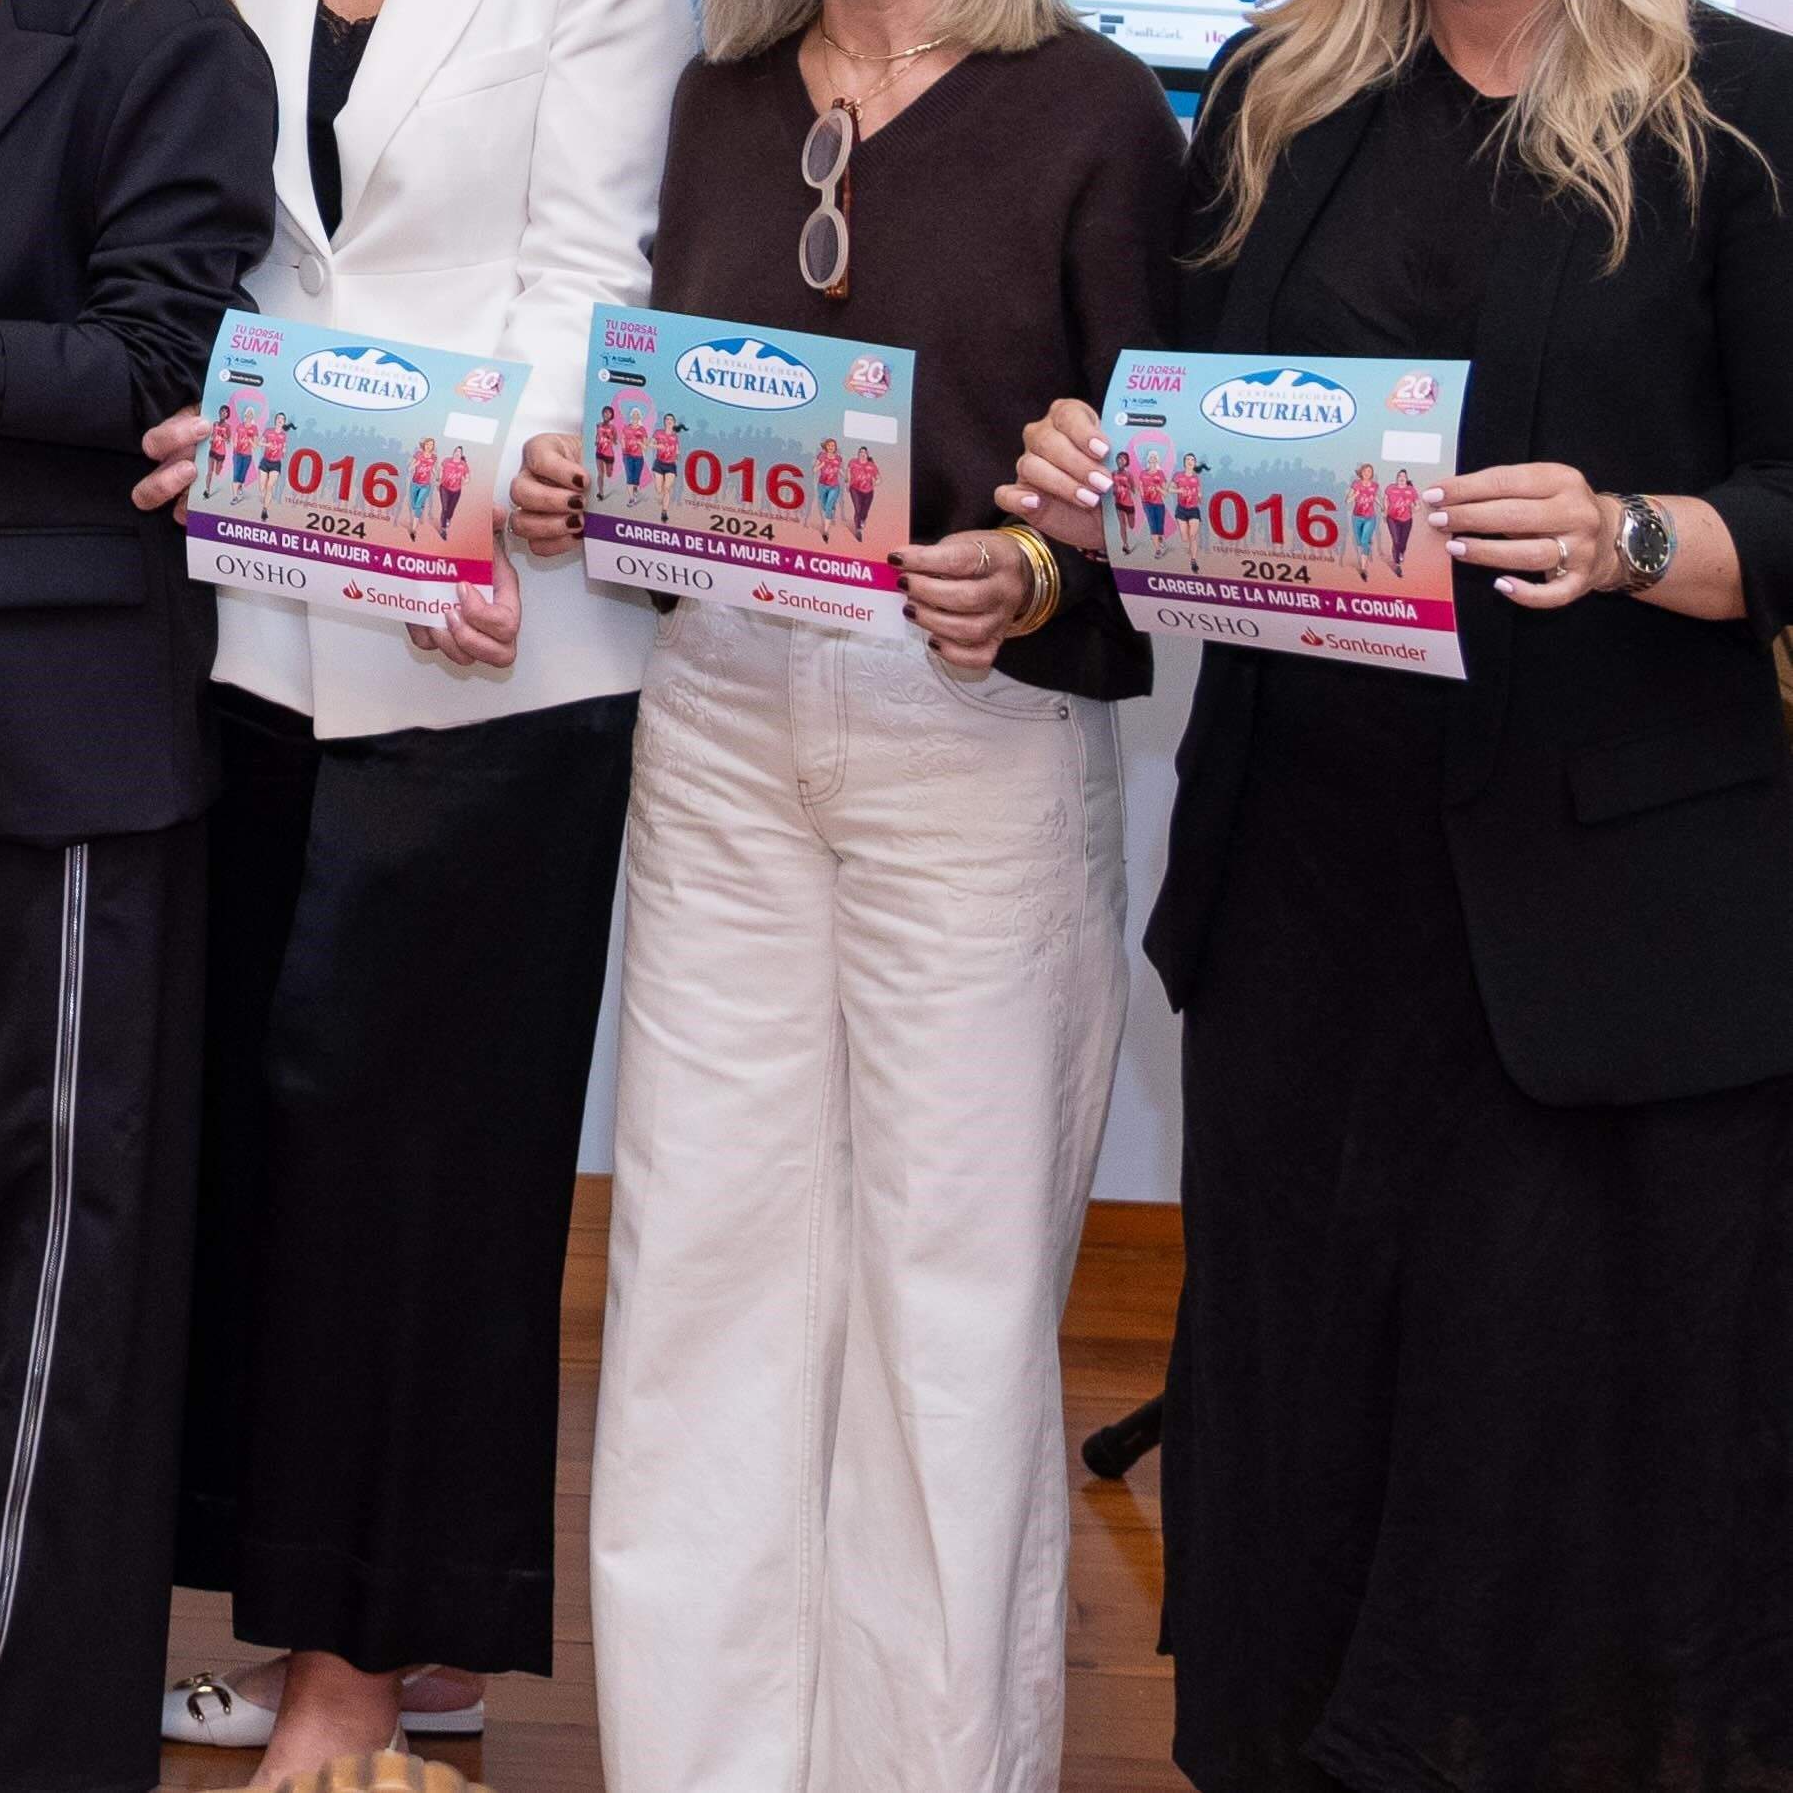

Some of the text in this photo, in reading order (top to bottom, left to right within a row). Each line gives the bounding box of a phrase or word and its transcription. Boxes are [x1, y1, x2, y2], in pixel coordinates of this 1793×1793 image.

[605, 333, 656, 353] SUMA
[302, 362, 417, 401] ASTURIANA
[686, 359, 806, 400] ASTURIANA
[1210, 392, 1343, 424] ASTURIANA
[288, 447, 399, 509] 016
[685, 450, 805, 509] 016
[306, 513, 366, 539] 2024
[710, 515, 775, 541] 2024
[1209, 490, 1339, 548] 016
[218, 522, 457, 577] CARRERA DE LA MUJER A CORUÑA
[616, 524, 872, 581] CARRERA DE LA MUJER A CORUÑA
[217, 555, 306, 588] OYSHO
[617, 556, 713, 590] OYSHO
[1242, 560, 1310, 583] 2024
[779, 590, 874, 621] Santander
[1147, 577, 1417, 620] CARRERA DE LA MUJER A CORUÑA
[1157, 609, 1259, 638] OYSHO
[1327, 634, 1427, 661] Santander
